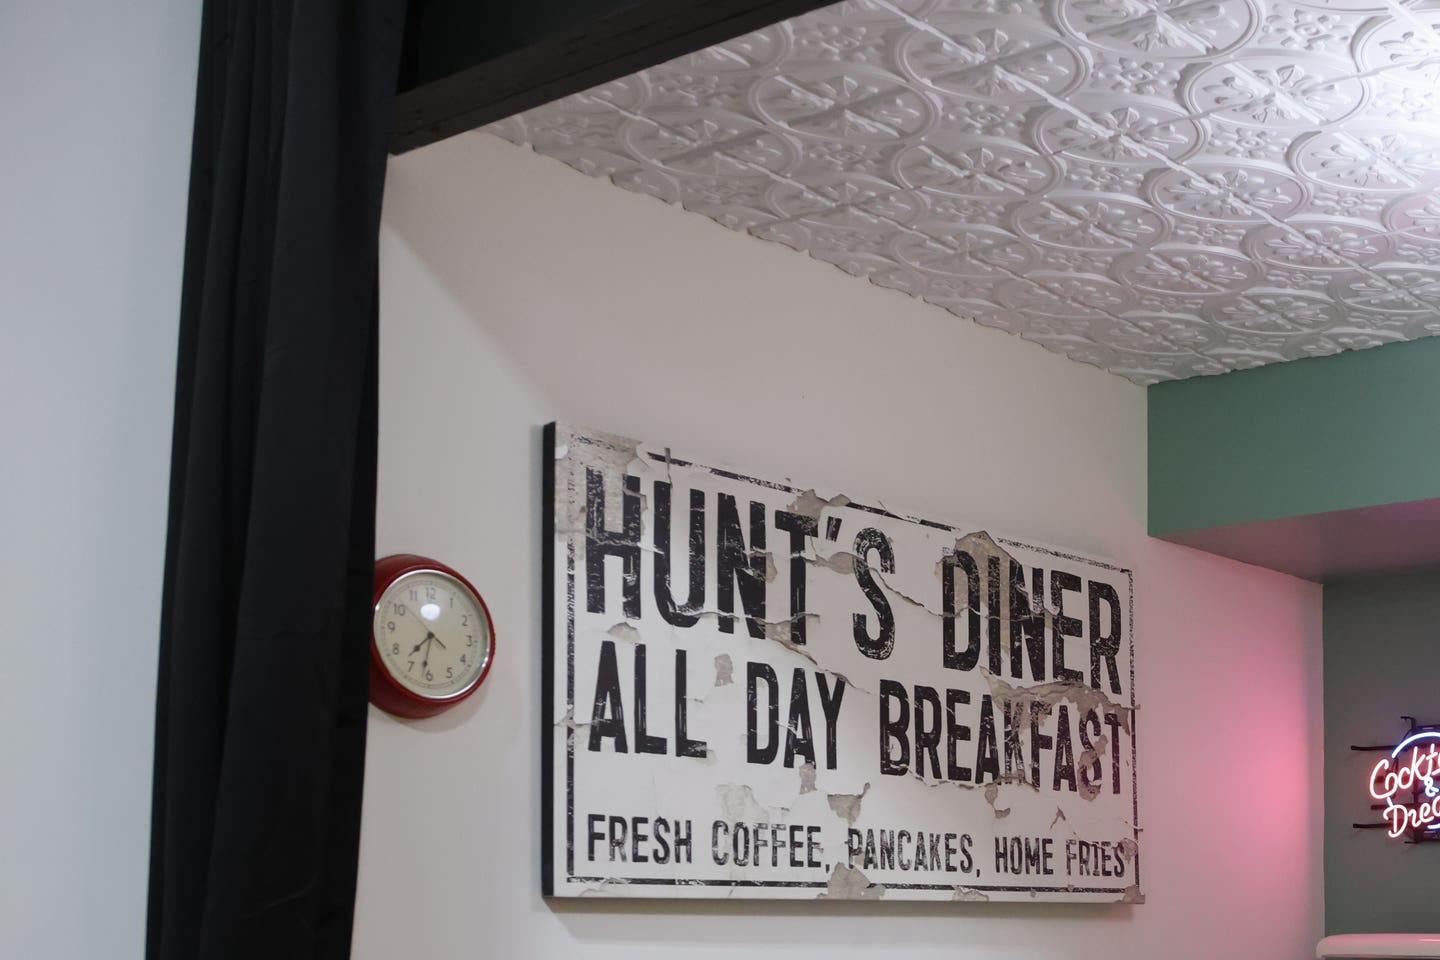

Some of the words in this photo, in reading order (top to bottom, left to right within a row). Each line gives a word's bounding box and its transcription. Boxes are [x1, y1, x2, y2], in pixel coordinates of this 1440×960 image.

[584, 465, 897, 661] HUNT'S
[940, 545, 1123, 696] DINER
[426, 587, 437, 600] 12
[394, 603, 406, 616] 10
[387, 621, 396, 633] 9
[461, 614, 469, 627] 2
[466, 635, 473, 647] 3
[392, 643, 400, 655] 8
[407, 660, 415, 673] 7
[446, 667, 454, 679] 5
[425, 669, 434, 682] 6
[587, 640, 708, 759] ALL
[746, 661, 846, 770] DAY
[878, 678, 1122, 801] BREAKFAST
[1423, 776, 1440, 797] &
[587, 813, 693, 866] FRESH
[711, 819, 831, 874] COFFEE,
[847, 827, 981, 878] PANCAKES,
[994, 836, 1055, 877] HOME
[1065, 838, 1126, 878] FRIES
